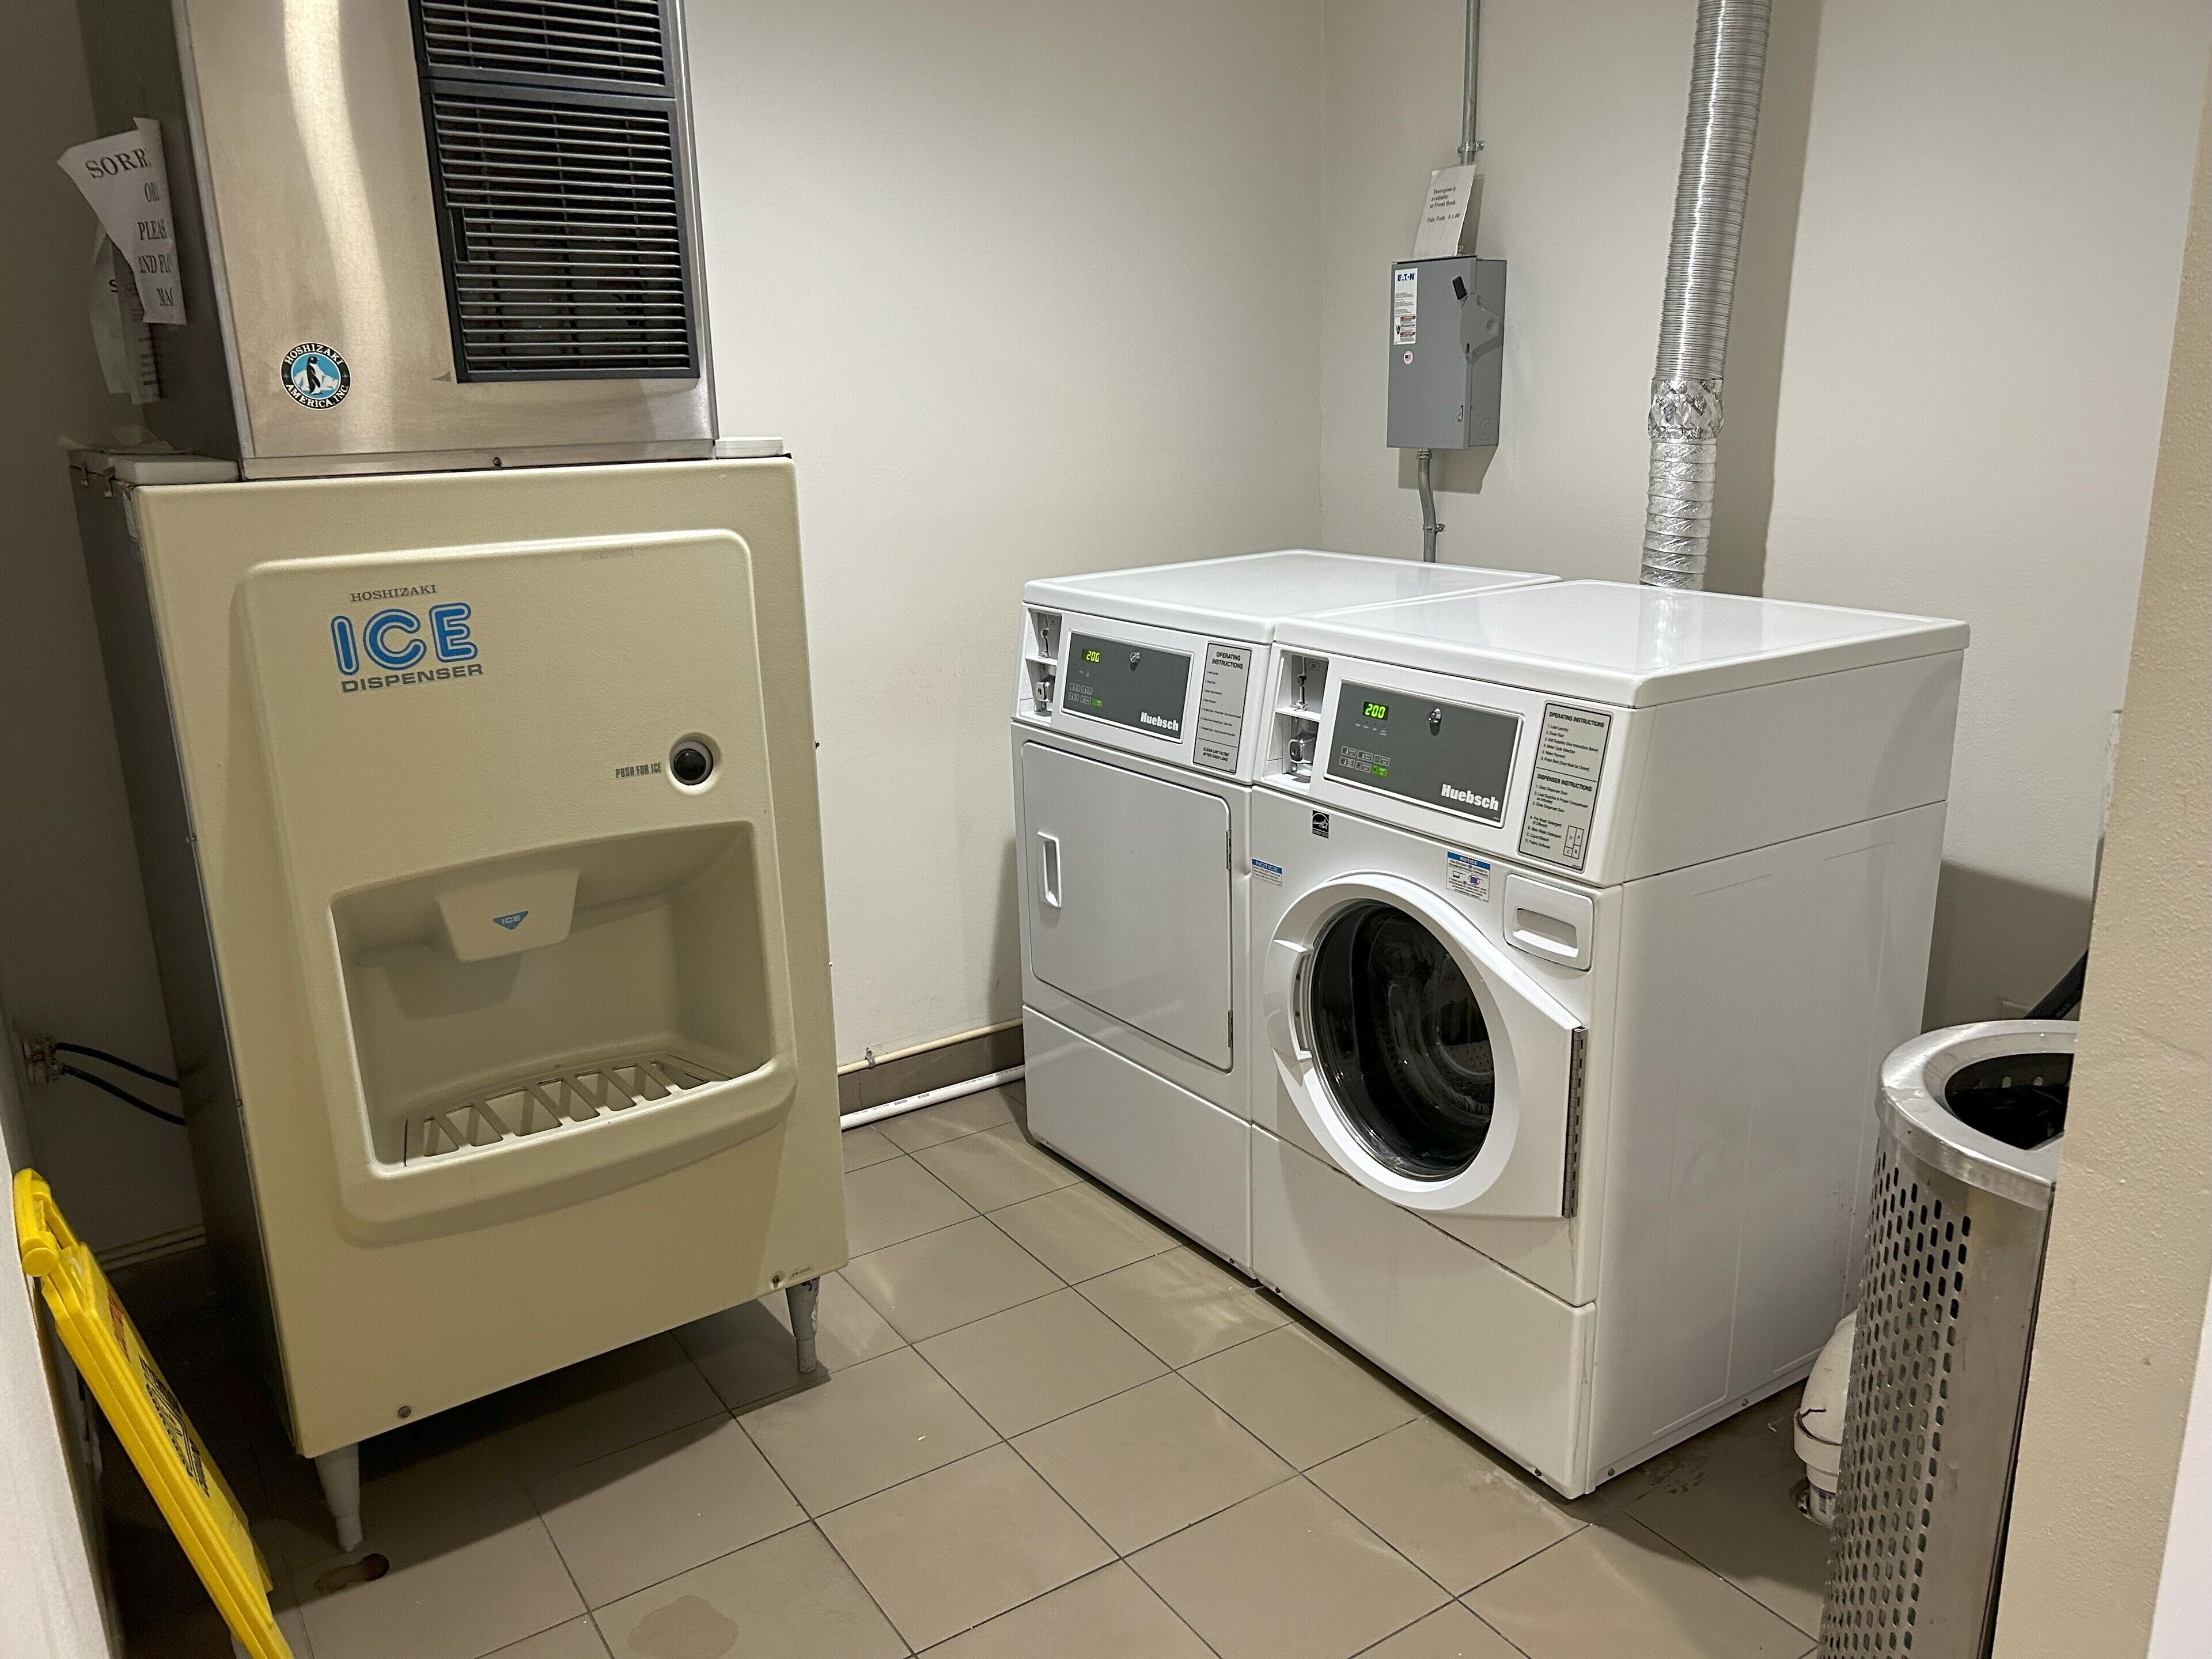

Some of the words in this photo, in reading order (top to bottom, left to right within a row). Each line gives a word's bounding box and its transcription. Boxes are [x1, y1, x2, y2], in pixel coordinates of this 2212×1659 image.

[85, 149, 151, 179] SORR
[284, 344, 344, 365] HOSHIZAKI
[350, 585, 437, 602] HOSHIZAKI
[331, 602, 478, 676] ICE
[1212, 658, 1243, 669] INSTRUCTIONS
[1216, 652, 1241, 661] OPERATING
[342, 664, 483, 692] DISPENSER
[1365, 703, 1386, 719] 200
[1549, 711, 1573, 722] OPERATING
[1573, 717, 1605, 728] INSTRUCTIONS
[1141, 711, 1179, 732] Huebsch
[615, 766, 635, 778] PUSH
[636, 764, 649, 775] FOR
[651, 763, 661, 773] ICE
[1537, 774, 1560, 784] DISPENSER
[1560, 779, 1592, 792] INSTRUCTIONS
[1441, 783, 1499, 811] Huebsch
[1256, 861, 1279, 872] NOTICE
[502, 915, 520, 925] ICE
